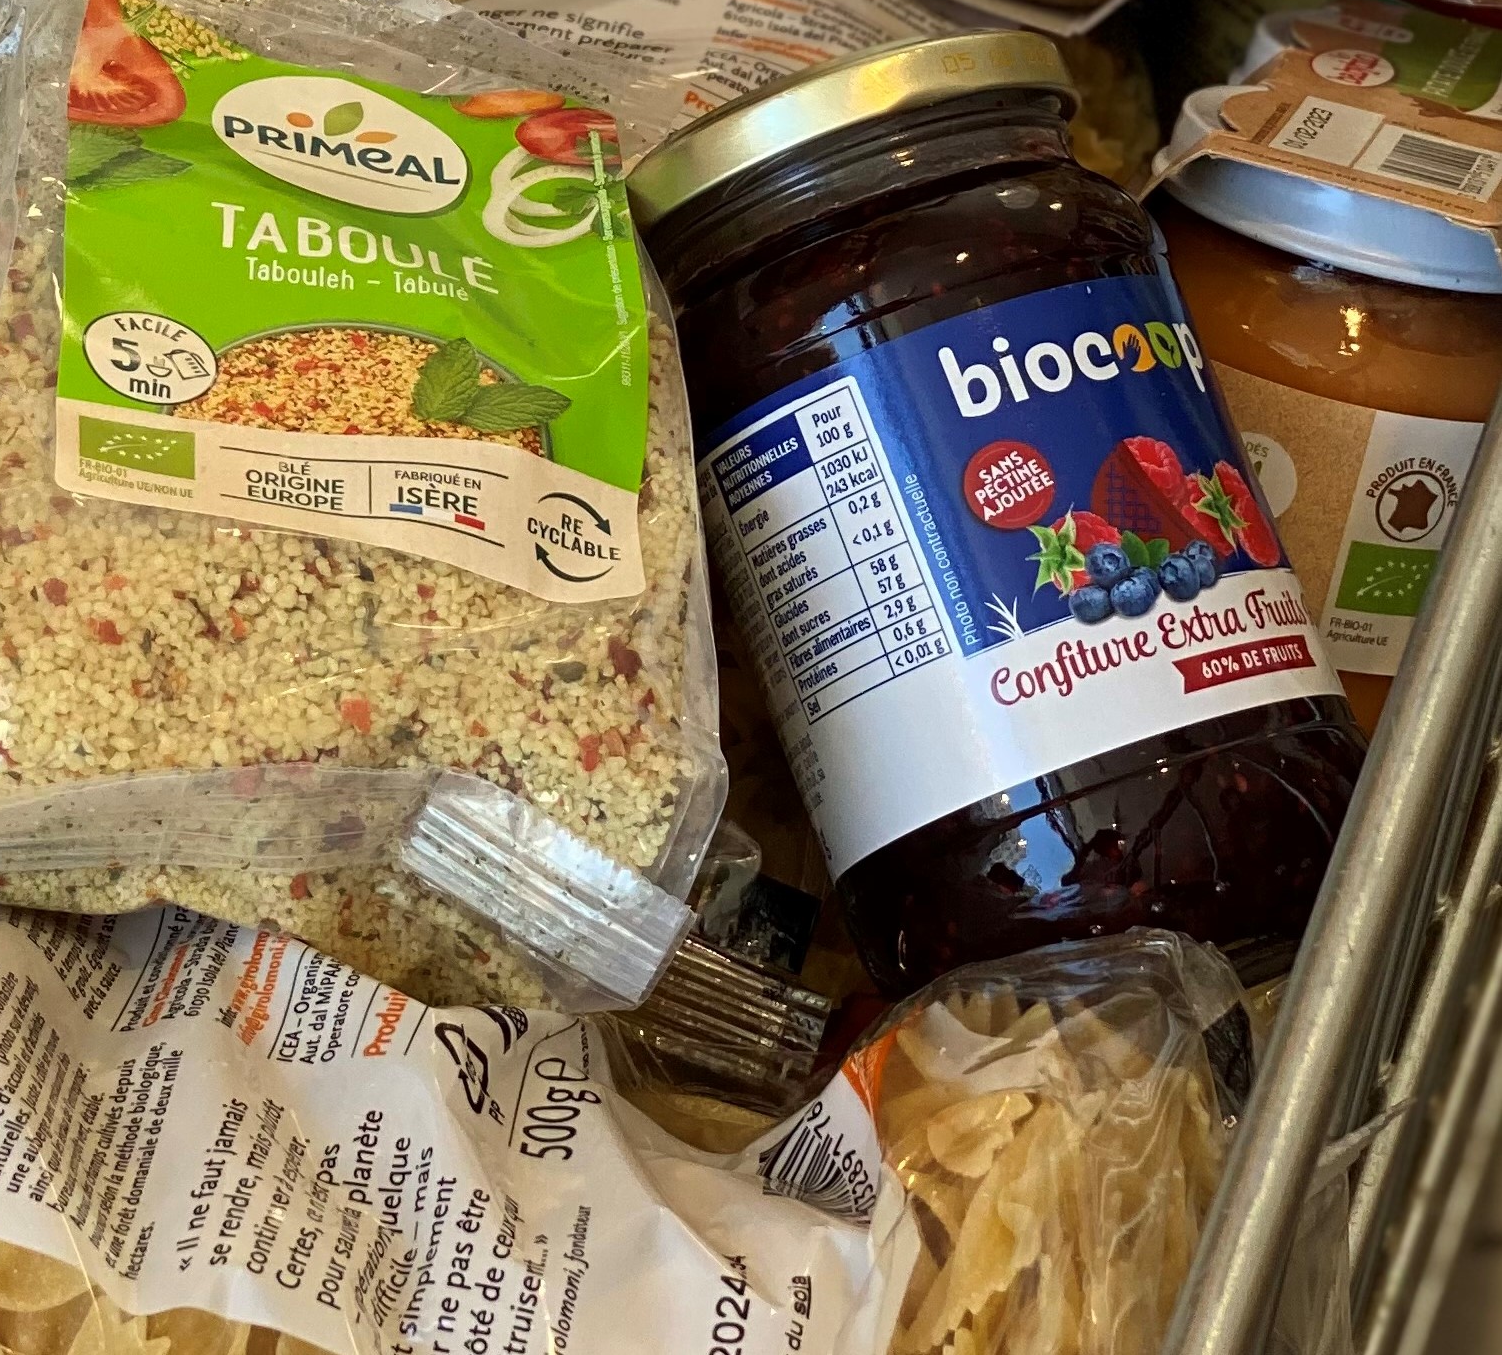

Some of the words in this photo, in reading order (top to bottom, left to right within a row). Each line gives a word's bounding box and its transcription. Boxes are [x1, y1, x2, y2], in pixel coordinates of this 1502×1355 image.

[210, 201, 499, 294] TABOULÉ
[245, 257, 354, 291] Tabouleh
[393, 273, 469, 301] Tabulé
[114, 317, 188, 342] FACILE
[110, 337, 141, 372] 5
[937, 321, 1205, 418] biocoop
[129, 375, 171, 399] min
[812, 405, 841, 427] Pour
[815, 427, 841, 447] 100
[79, 459, 128, 477] FR-BIO-01
[278, 461, 310, 475] BLÉ
[717, 445, 752, 474] VALEURS
[723, 437, 799, 492] NUTRITIONNELLES
[820, 455, 851, 479] 1030
[854, 446, 869, 466] kJ
[977, 451, 1023, 485] SANS
[79, 467, 134, 489] Agriculture
[136, 481, 177, 495] UE/NON
[179, 488, 193, 498] UE
[246, 469, 344, 495] ORIGINE
[394, 469, 460, 487] FABRIQUÉ
[463, 478, 482, 491] EN
[729, 471, 773, 505] MOYENNES
[826, 479, 849, 499] 243
[851, 463, 878, 490] kcal
[974, 460, 1042, 506] PECTINE
[982, 471, 1054, 522] AJOUTÉE
[1366, 457, 1416, 498] PRODUIT
[1419, 457, 1436, 469] EN
[1433, 461, 1458, 507] FRANCE
[247, 485, 344, 511] EUROPE
[398, 481, 478, 517] ISÈRE
[561, 513, 584, 537] RE
[739, 510, 769, 537] Énergie
[788, 517, 827, 551] grasses
[905, 473, 951, 569] contractuelle
[527, 517, 621, 561] CYCLABLE
[943, 571, 963, 600] non
[774, 599, 809, 630] Glucides
[955, 602, 981, 645] Photo
[1329, 616, 1373, 633] FR-BIO-01
[813, 616, 871, 655] alimentaires
[1327, 630, 1376, 646] Agriculture
[990, 631, 1157, 706] Confiture
[1160, 604, 1241, 648] Extra
[1201, 656, 1239, 679] 60%
[1242, 651, 1262, 668] DE
[1264, 643, 1303, 663] FRUITS
[798, 663, 838, 693] Protéines
[218, 1098, 249, 1154] jamais
[342, 1109, 383, 1206] planète
[456, 1189, 490, 1234] être
[276, 1226, 318, 1290] Certes,
[399, 1176, 457, 1337] simplement
[370, 1251, 418, 1329] difficile
